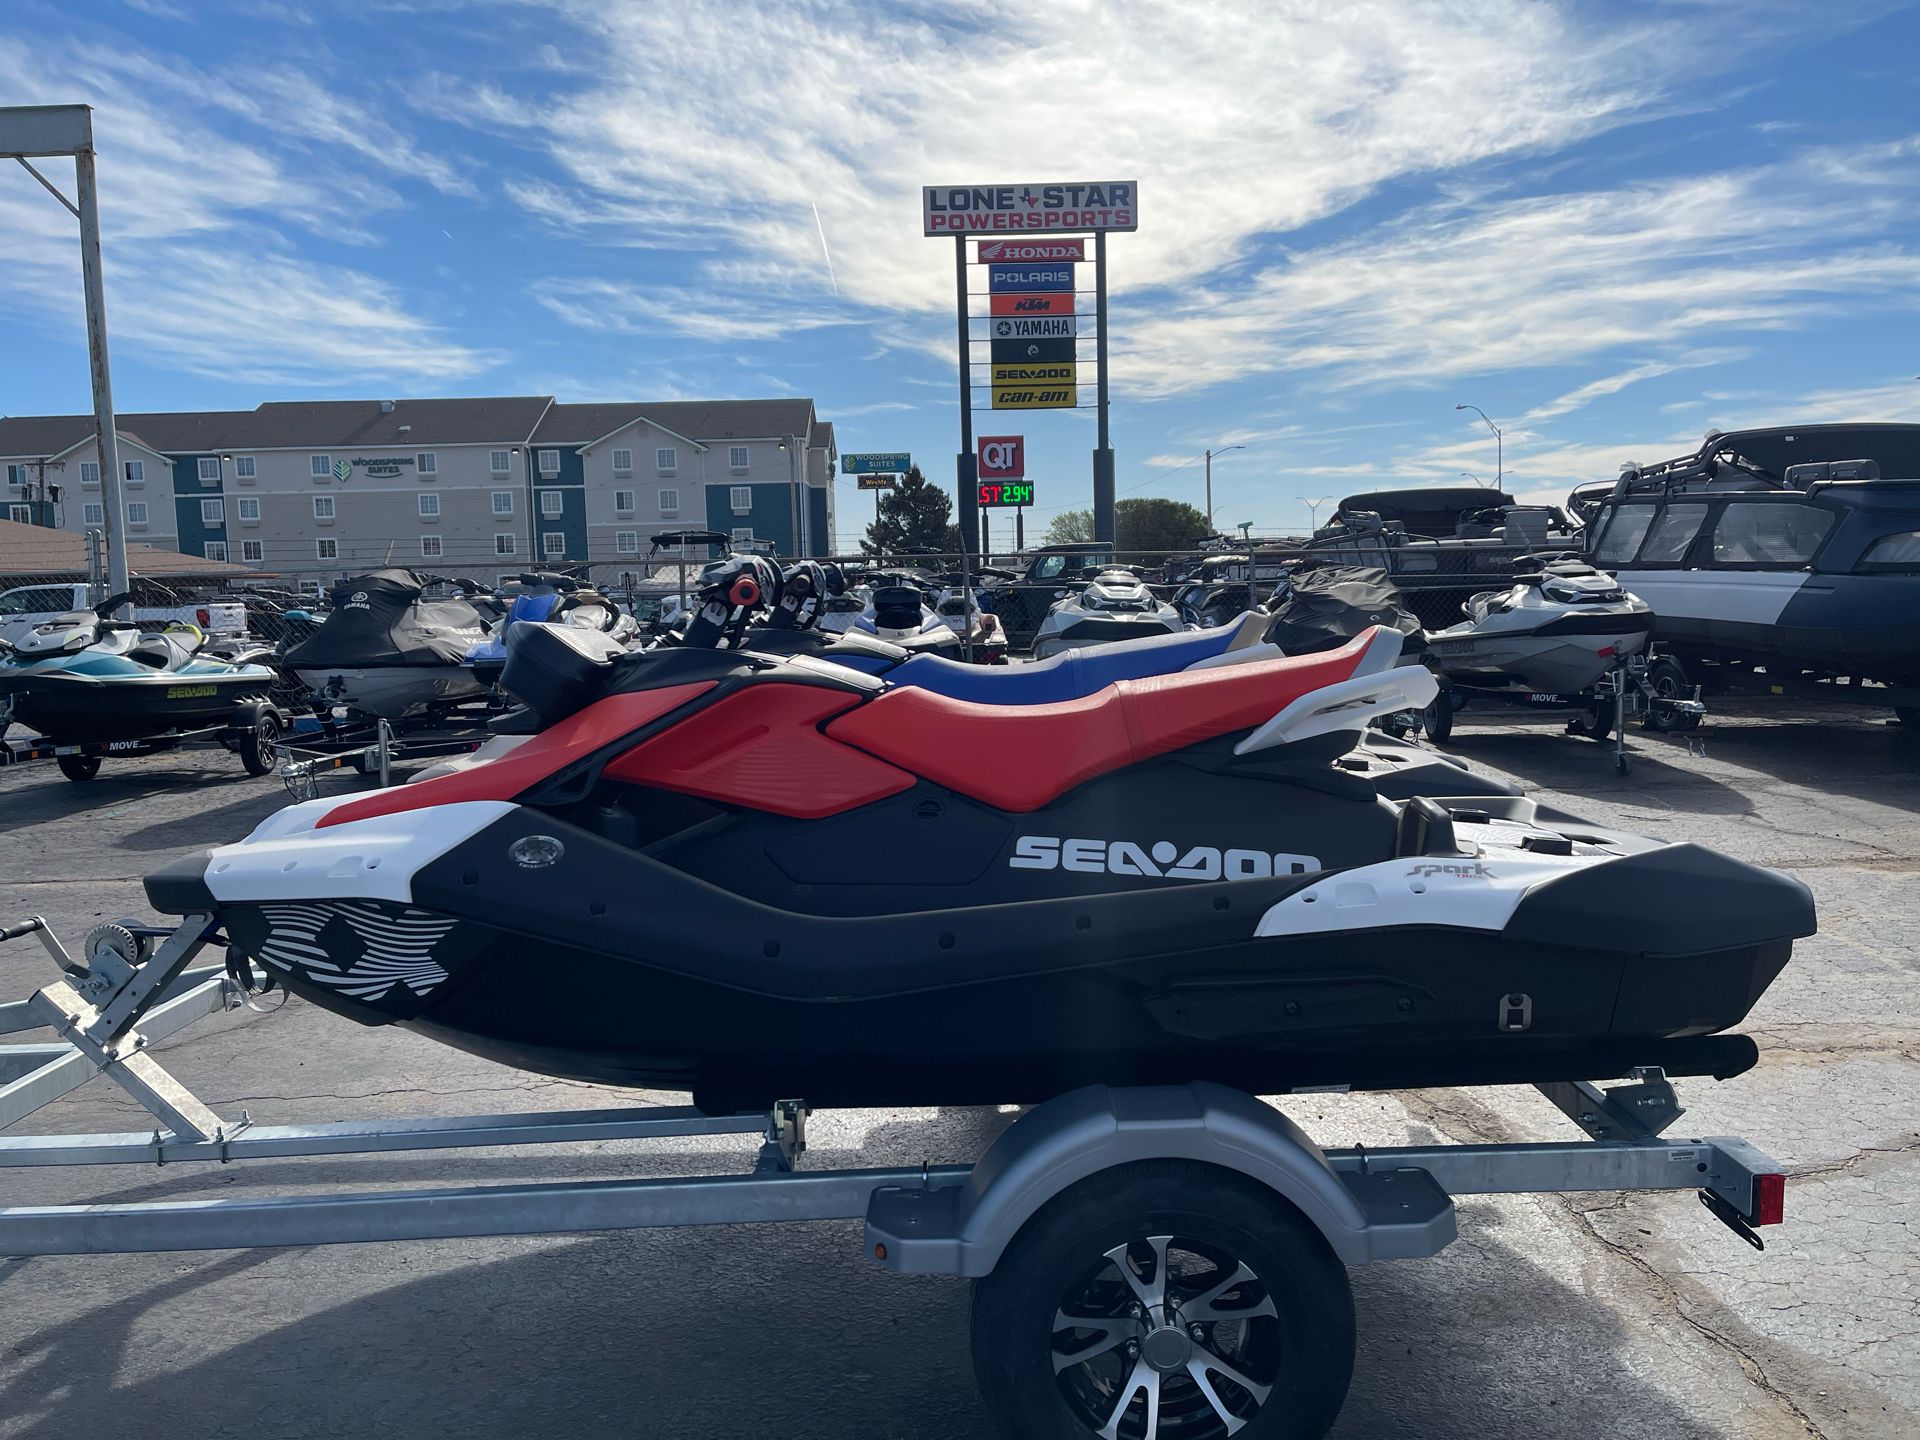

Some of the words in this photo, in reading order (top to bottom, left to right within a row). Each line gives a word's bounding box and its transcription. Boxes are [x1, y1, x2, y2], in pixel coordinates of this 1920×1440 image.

[930, 188, 1015, 211] LONE
[1043, 184, 1131, 208] STAR
[930, 209, 1131, 230] POWERSPORTS
[1004, 246, 1082, 258] HONDA
[994, 271, 1070, 283] POLARIS
[1014, 298, 1051, 311] KTM
[1014, 319, 1070, 336] YAMAHA
[351, 457, 415, 466] WOODSPRING
[855, 453, 909, 461] WOODSPRING
[982, 442, 1017, 469] QT
[367, 466, 400, 474] SUITES
[868, 460, 896, 468] SUITES
[1531, 693, 1559, 703] MOVE
[109, 740, 140, 751] MOVE
[1406, 863, 1499, 880] spark
